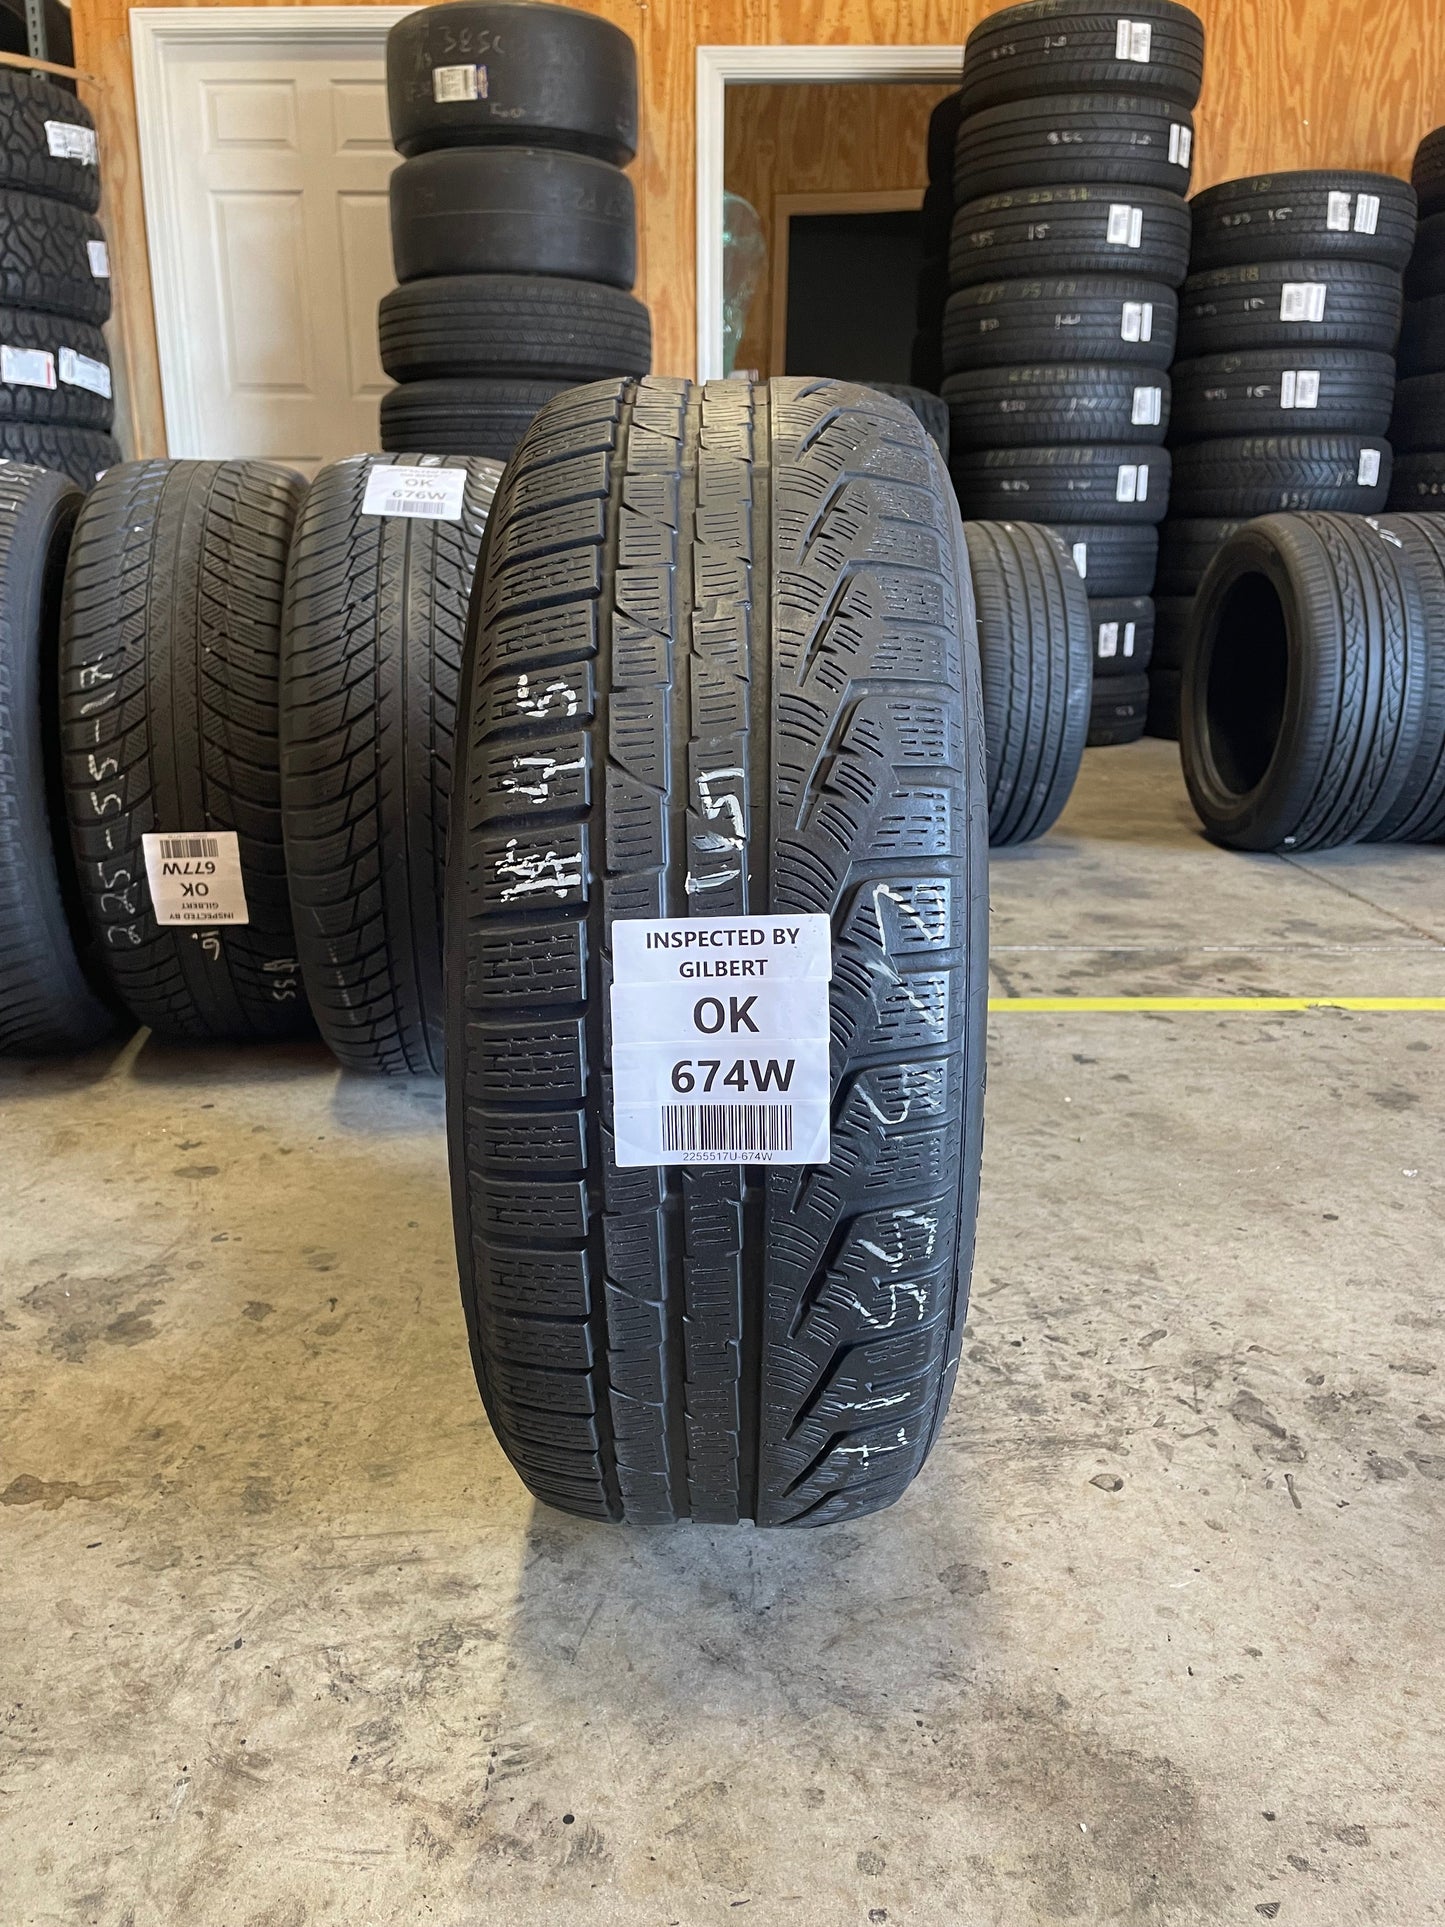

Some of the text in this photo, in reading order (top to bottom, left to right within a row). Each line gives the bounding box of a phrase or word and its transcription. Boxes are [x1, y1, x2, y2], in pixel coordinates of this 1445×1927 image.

[405, 479, 433, 487] OK
[392, 489, 447, 500] 676W
[162, 861, 216, 876] 677W
[180, 882, 209, 897] OK
[181, 902, 219, 910] GILBERT
[169, 912, 234, 921] INSPECTED BY
[646, 927, 800, 949] INSPECTED BY
[679, 959, 768, 978] GILBERT
[693, 995, 760, 1034] OK
[670, 1058, 796, 1093] 674W
[682, 1151, 773, 1161] 2255517U-674W
